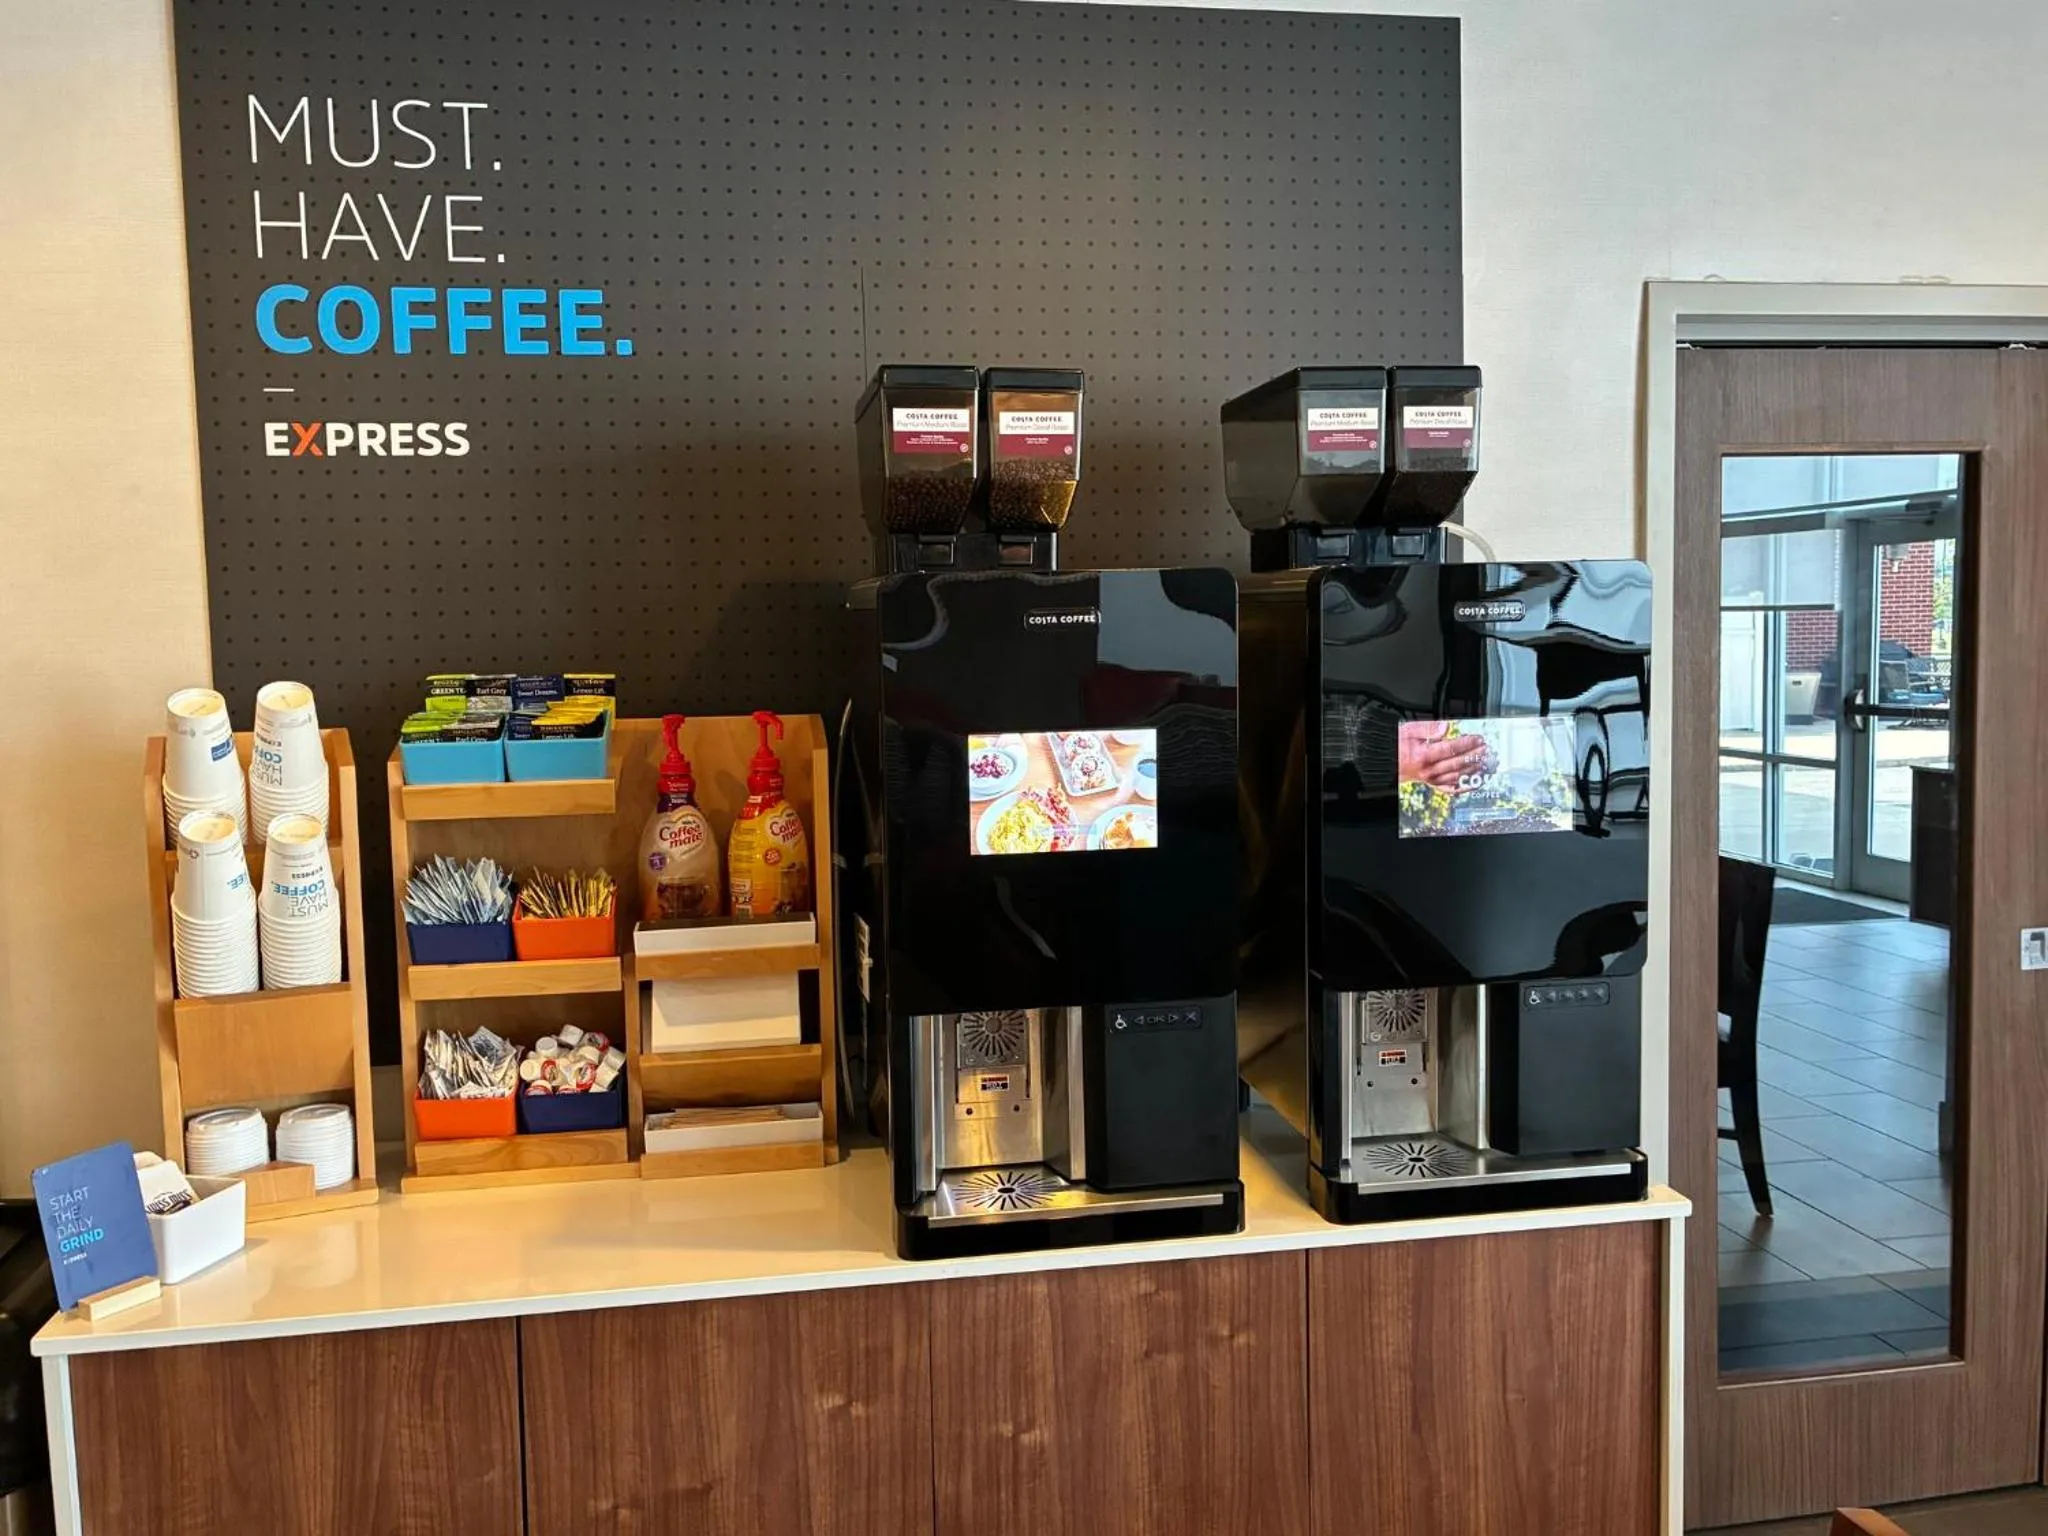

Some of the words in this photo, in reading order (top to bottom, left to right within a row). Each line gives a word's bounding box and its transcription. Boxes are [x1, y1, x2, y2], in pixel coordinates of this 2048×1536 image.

[247, 93, 501, 170] MUST.
[253, 189, 505, 263] HAVE.
[255, 283, 633, 356] COFFEE.
[1342, 411, 1367, 419] COFFEE
[1437, 410, 1462, 418] COFFEE
[264, 421, 471, 457] EXPRESS
[1459, 606, 1485, 615] COSTA
[1487, 605, 1522, 614] COFFEE
[1028, 616, 1058, 625] COSTA
[1059, 615, 1096, 624] COFFEE
[456, 687, 467, 695] TE
[476, 687, 489, 695] Earl
[490, 687, 507, 697] Grey
[659, 824, 699, 842] Coffee
[50, 1186, 90, 1211] START
[52, 1206, 80, 1224] THE
[57, 1215, 93, 1240] DAILY
[60, 1228, 104, 1252] GRIND
